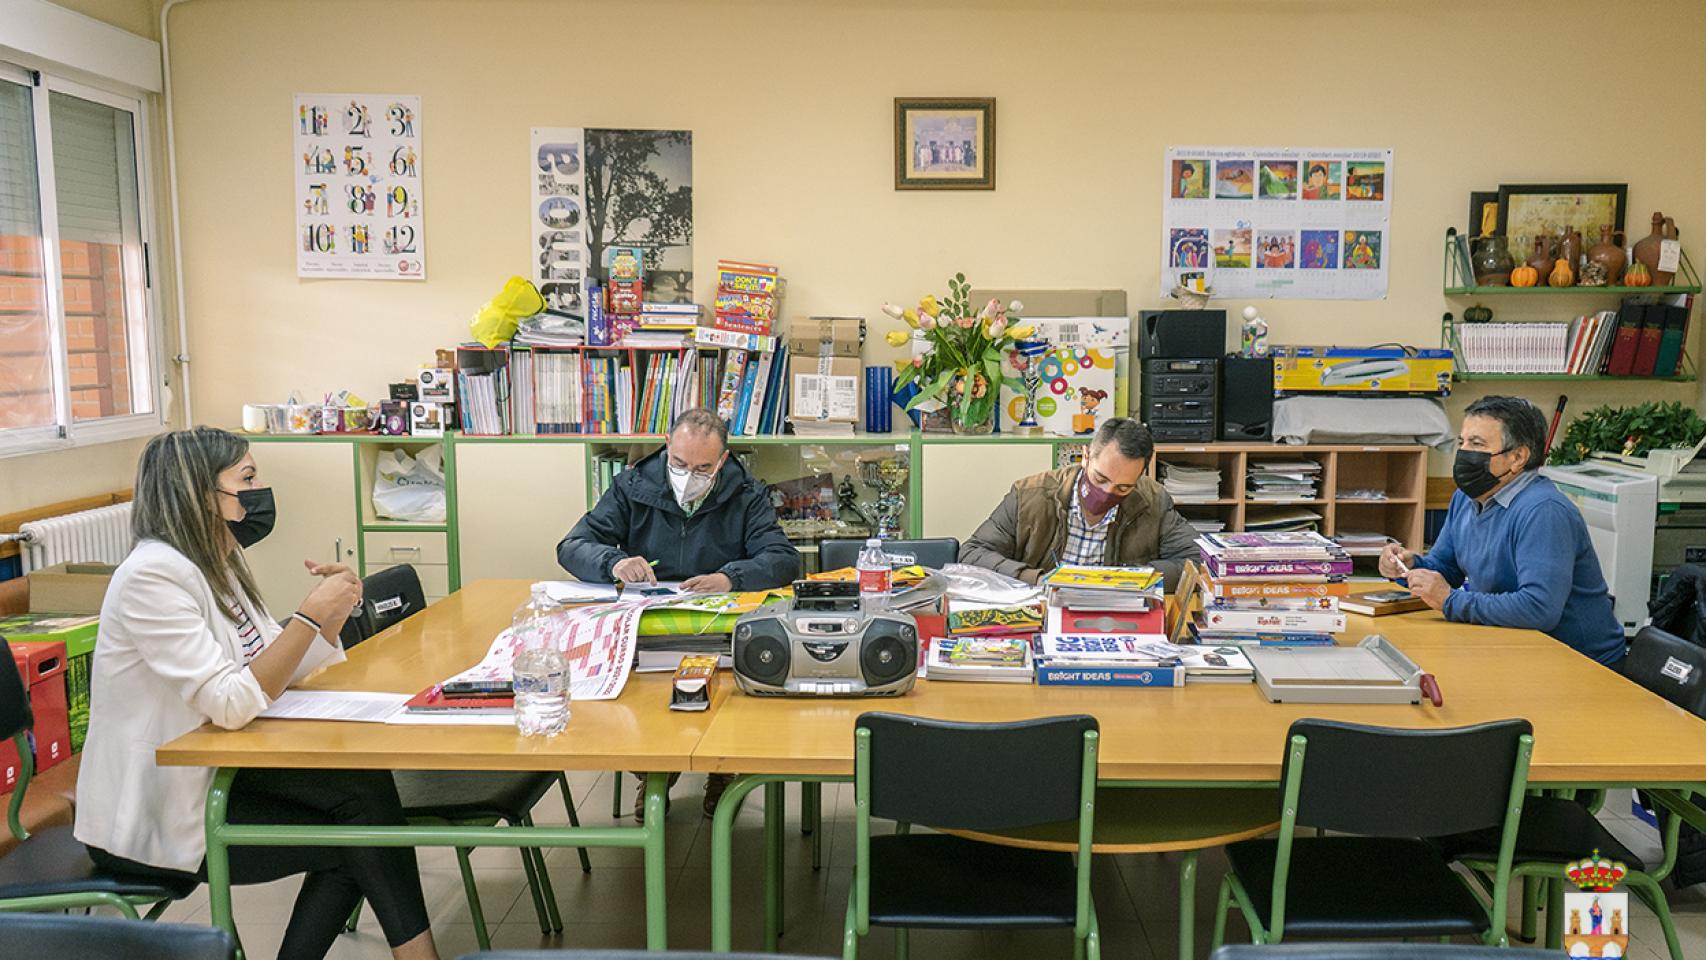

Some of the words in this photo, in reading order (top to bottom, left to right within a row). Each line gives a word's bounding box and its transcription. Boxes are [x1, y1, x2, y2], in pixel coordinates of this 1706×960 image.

[348, 105, 365, 135] 2
[390, 106, 406, 136] 3
[350, 145, 365, 174] 5
[393, 145, 408, 176] 6
[351, 185, 366, 214] 8
[393, 185, 408, 215] 9
[308, 223, 331, 254] 10
[391, 225, 417, 254] 12
[1235, 563, 1264, 573] BRIGHT
[1266, 564, 1293, 572] IDEAS
[1047, 671, 1080, 681] BRIGHT
[1082, 672, 1112, 681] IDEAS
